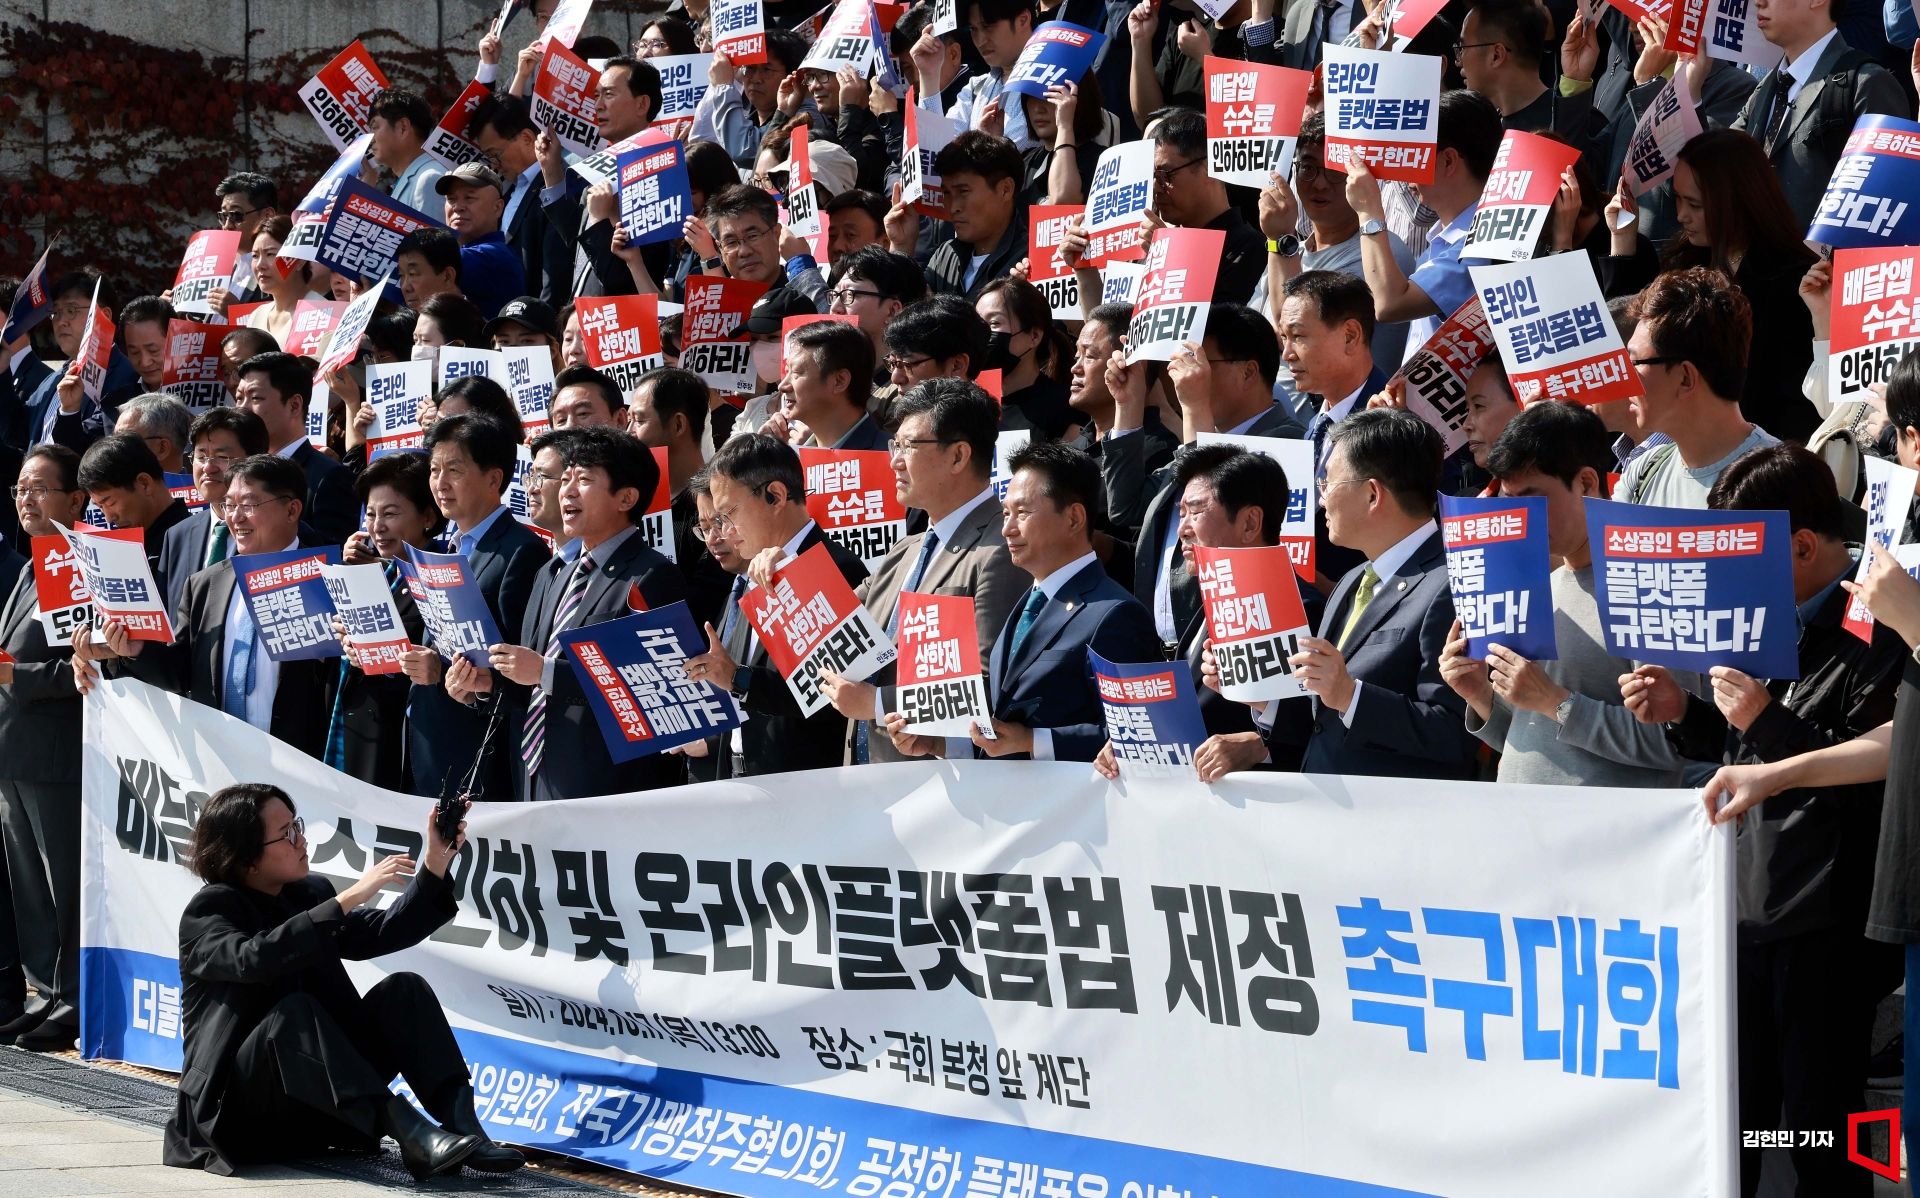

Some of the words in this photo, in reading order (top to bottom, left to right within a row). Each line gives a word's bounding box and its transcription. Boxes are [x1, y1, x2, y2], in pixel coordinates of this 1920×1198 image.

[546, 53, 592, 92] 배달앱
[1209, 71, 1258, 104] 배달앱
[1327, 63, 1378, 95] 온라인
[551, 83, 597, 121] 수수료
[1222, 103, 1275, 136] 수수료
[1338, 98, 1430, 131] 플랫폼법
[535, 97, 601, 151] 인하하라!
[621, 164, 645, 183] 소상공인
[645, 153, 676, 173] 우롱하는
[1212, 140, 1284, 173] 인하하라!
[347, 197, 393, 225] 소상공인
[622, 173, 660, 211] 플랫폼
[1091, 180, 1148, 225] 플랫폼법
[331, 211, 403, 258] 플랫폼
[622, 195, 682, 241] 규탄한다!
[687, 283, 724, 314] 수수료
[1482, 275, 1539, 325] 온라인
[1841, 258, 1913, 306] 배달앱
[578, 303, 614, 334] 수수료
[691, 312, 742, 342] 상한제
[1507, 301, 1608, 366] 플랫폼법
[170, 334, 206, 359] 배달앱
[598, 327, 641, 360] 상한제
[175, 355, 220, 381] 수수료
[507, 357, 529, 389] 온라인
[736, 380, 754, 390] 민주당
[1544, 353, 1630, 398] 촉구한다!
[371, 374, 407, 403] 온라인
[806, 459, 861, 495] 배달앱
[827, 489, 885, 526] 수수료
[1463, 512, 1522, 538] 우롱하는
[1608, 532, 1671, 558] 소상공인
[1678, 528, 1757, 556] 우롱하는
[248, 573, 281, 598] 소상공인
[282, 557, 321, 589] 우롱하는
[1605, 561, 1707, 607] 플랫폼
[252, 585, 306, 623] 플랫폼
[756, 576, 802, 634] 수수료
[783, 590, 839, 657] 상한제
[902, 603, 939, 643] 수수료
[1209, 591, 1271, 644] 상한제
[1609, 606, 1766, 653] 규탄한다!
[588, 642, 618, 686] 우롱하는
[793, 613, 876, 709] 도입하라!
[876, 648, 896, 666] 민주당
[914, 637, 962, 679] 상한제
[616, 661, 685, 738] 플랫폼
[901, 678, 979, 724] 도입하라!
[1123, 677, 1172, 700] 우롱하는
[605, 686, 648, 739] 소상공인
[1102, 702, 1158, 741] 플랫폼
[552, 850, 628, 968] 및
[634, 851, 1139, 1014] 온라인플랫폼법
[1151, 884, 1320, 1036] 제정
[1335, 897, 1680, 1089] 촉구대회
[487, 984, 545, 1024] 일시
[700, 1020, 781, 1060] 13:00
[801, 1025, 868, 1074] 장소
[883, 1030, 935, 1085] 국회
[941, 1039, 991, 1096] 본청
[996, 1046, 1027, 1101] 앞
[1027, 1051, 1091, 1110] 계단
[466, 1062, 558, 1136] 위원회,
[552, 1082, 847, 1191] 전국가맹점주협의회,
